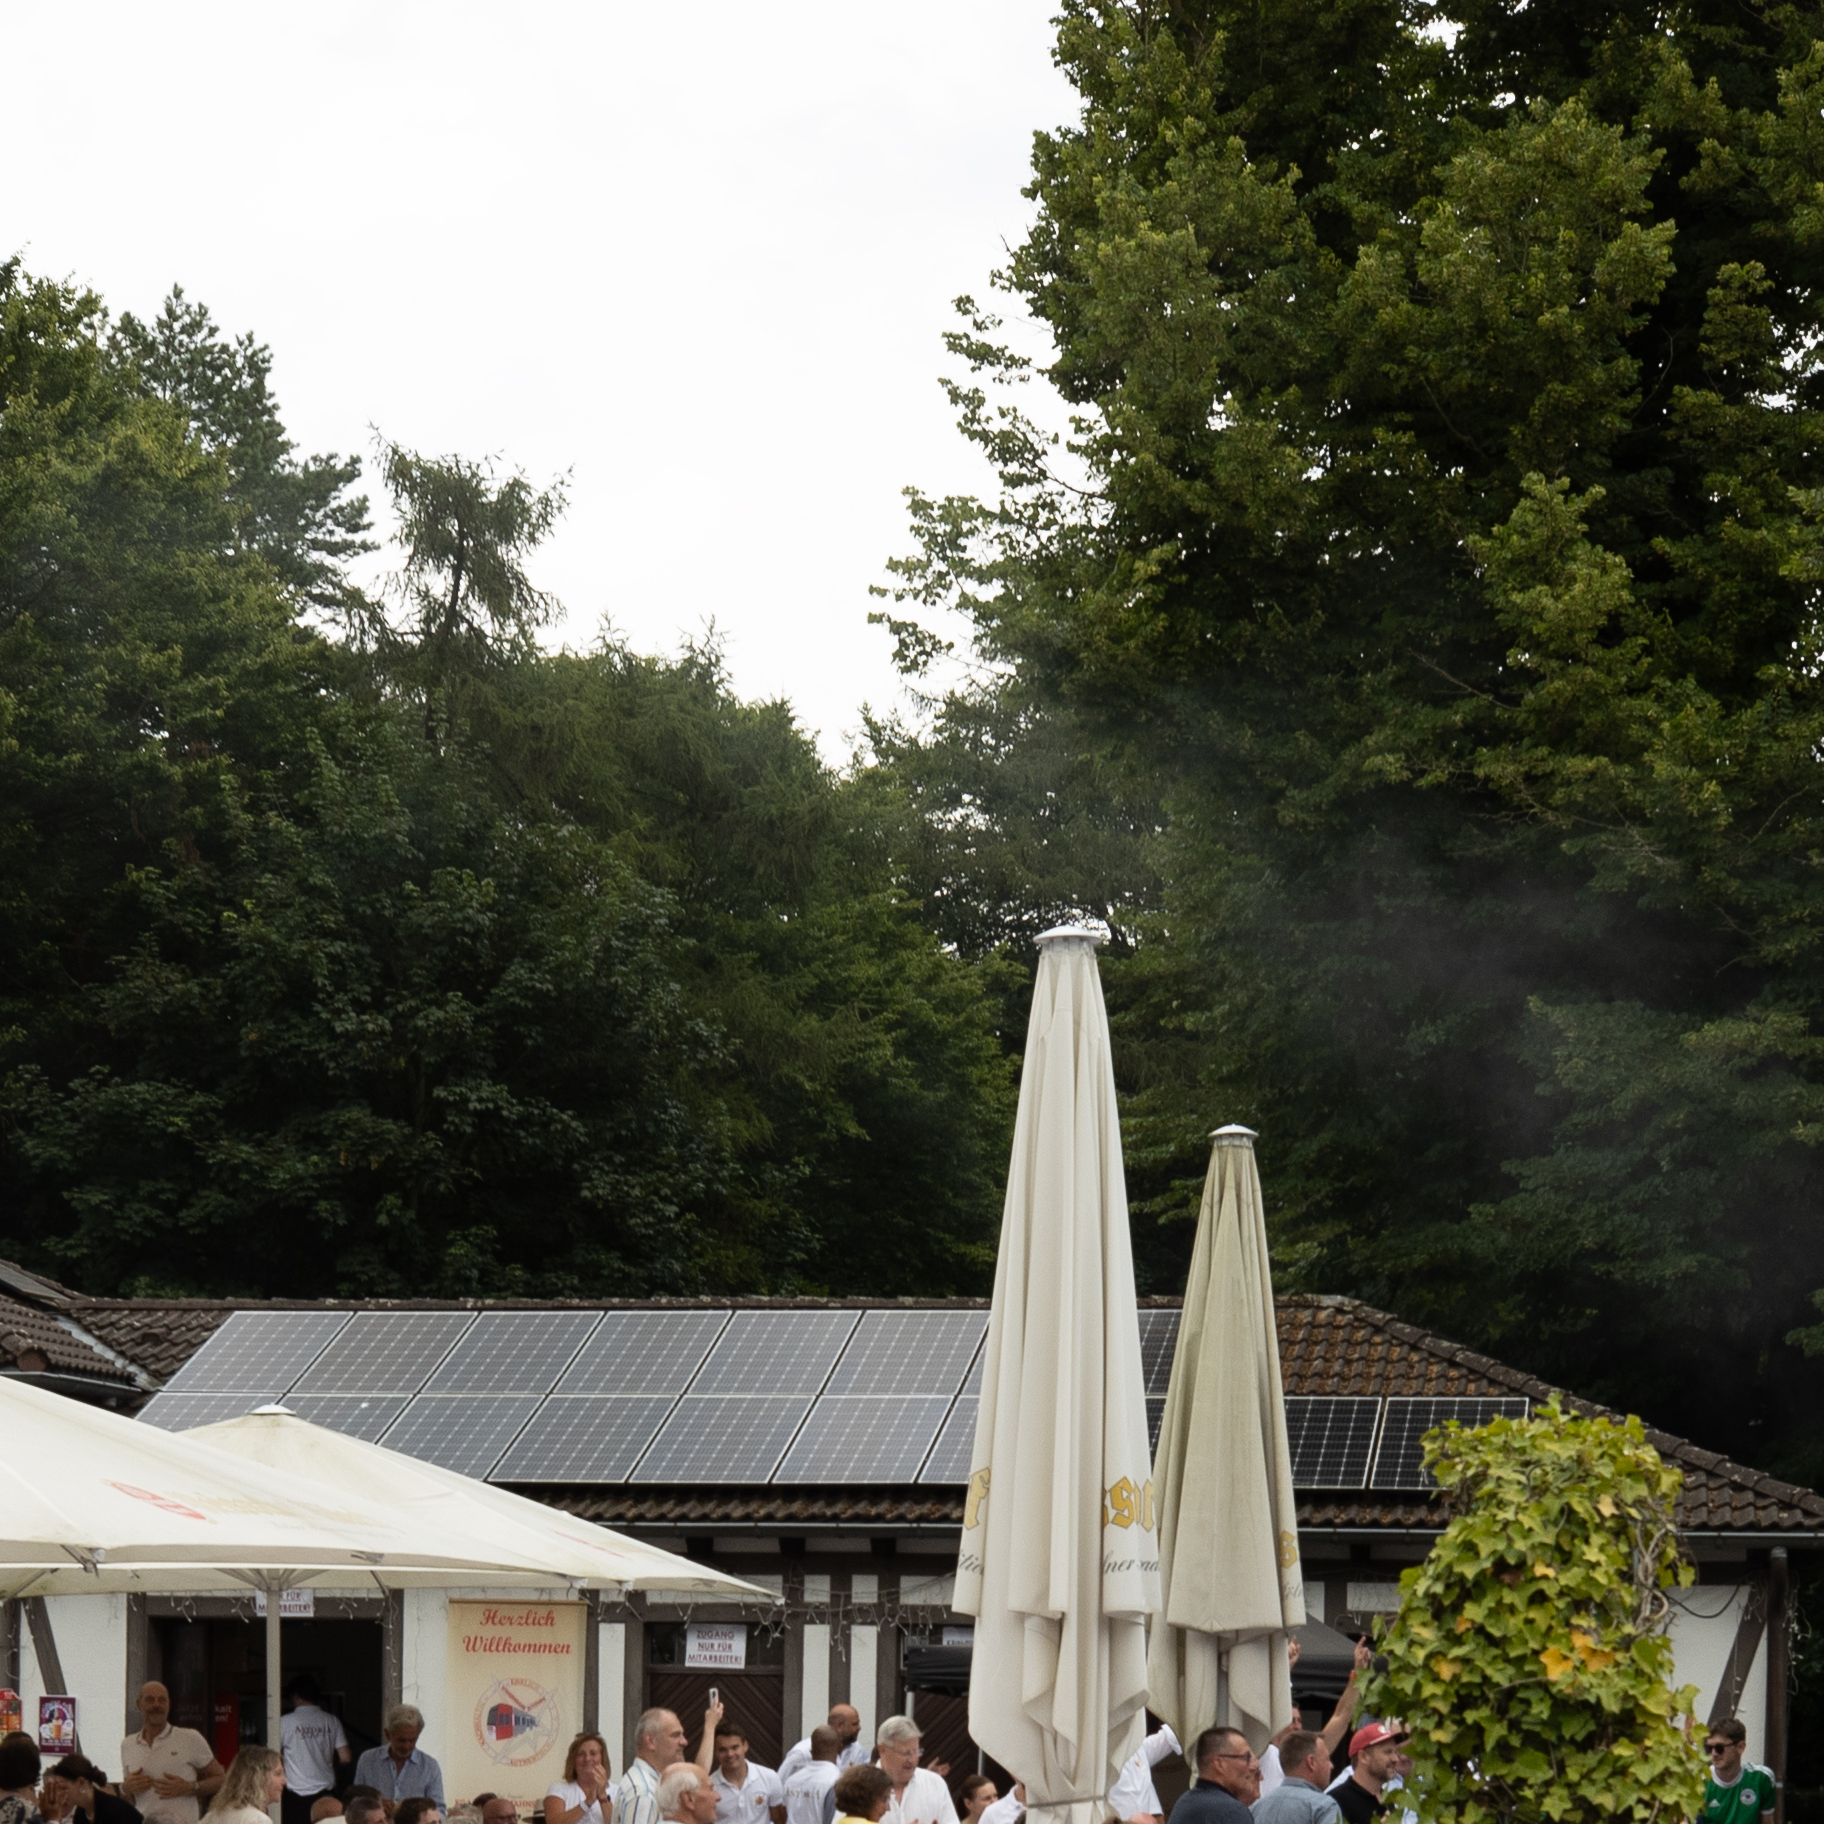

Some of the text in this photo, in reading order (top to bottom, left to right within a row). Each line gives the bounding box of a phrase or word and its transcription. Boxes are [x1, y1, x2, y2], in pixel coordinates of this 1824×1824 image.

[480, 1608, 556, 1627] Herzlich
[696, 1630, 735, 1640] ZUGANG
[463, 1635, 572, 1655] Willkommen
[697, 1641, 733, 1652] NUR FÜR
